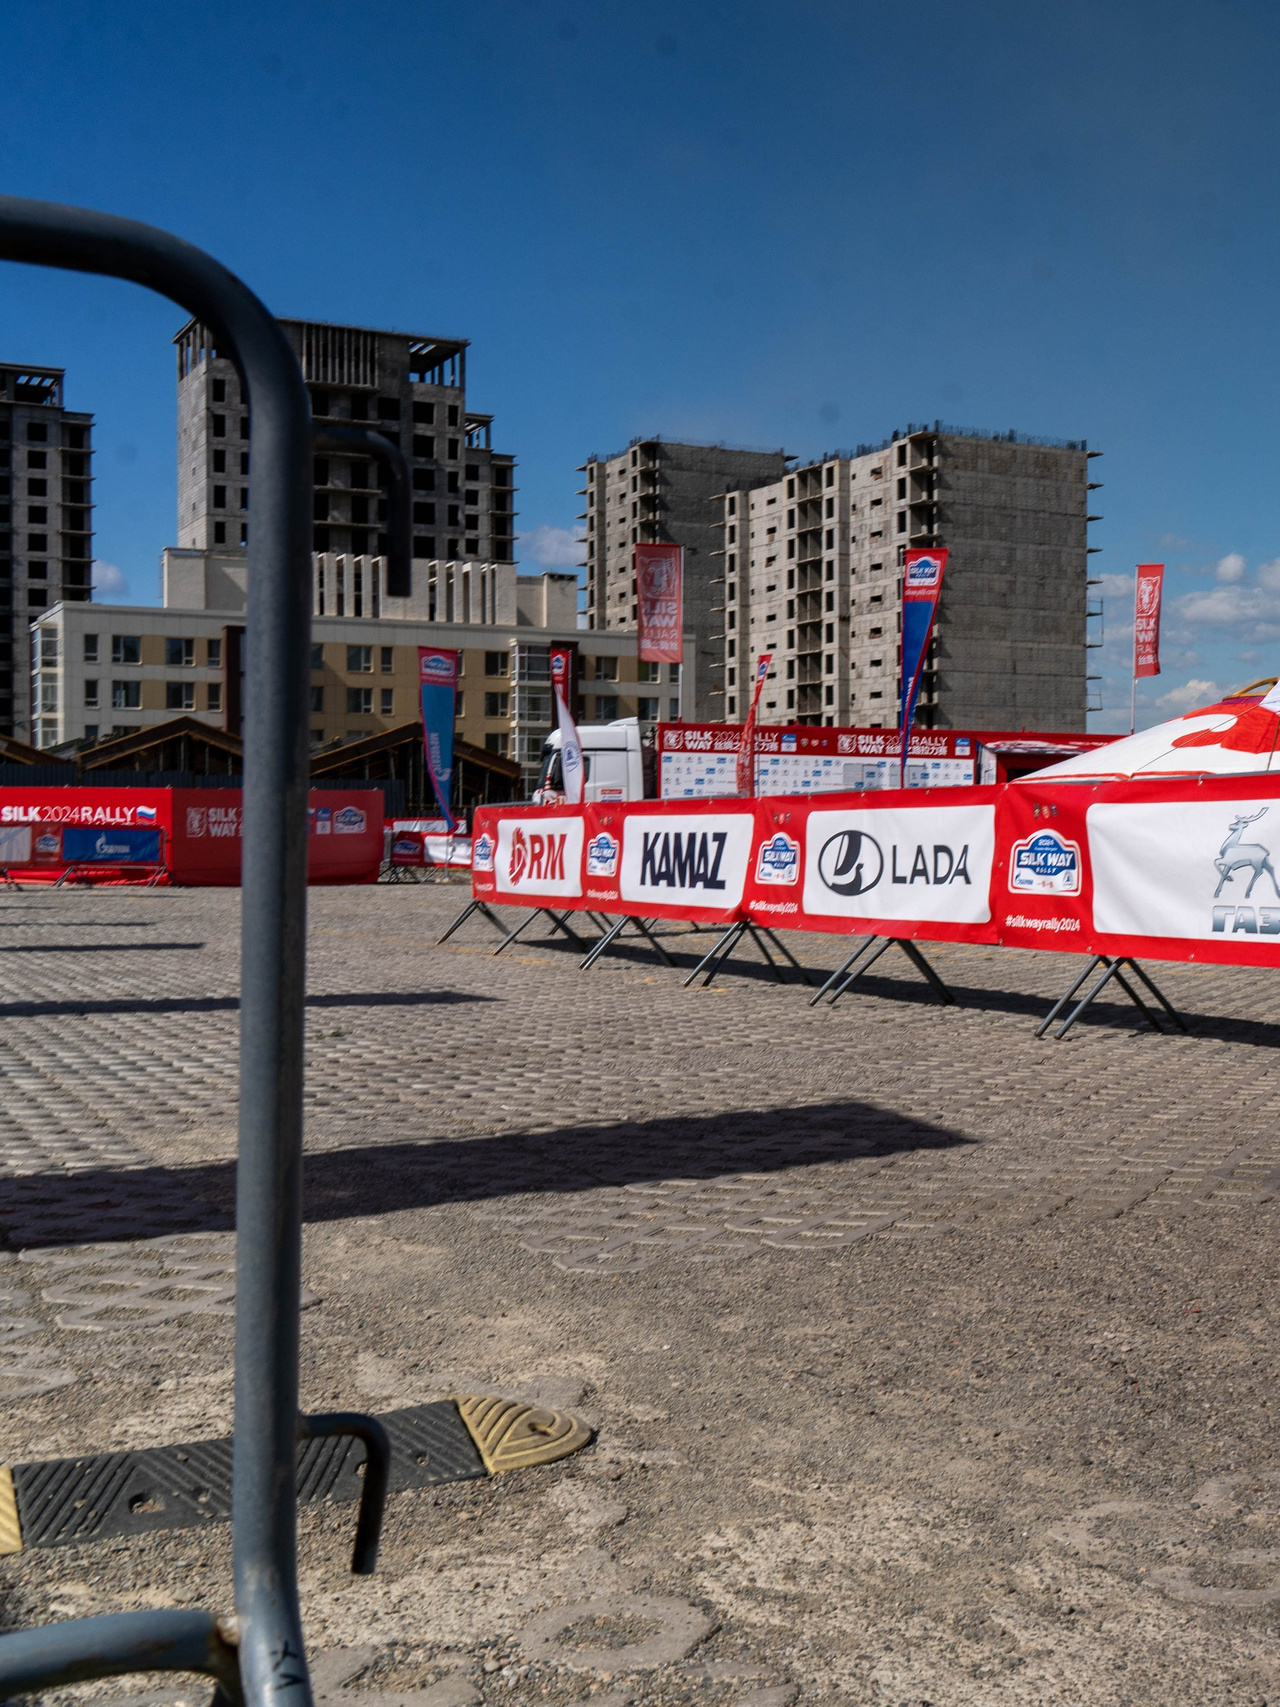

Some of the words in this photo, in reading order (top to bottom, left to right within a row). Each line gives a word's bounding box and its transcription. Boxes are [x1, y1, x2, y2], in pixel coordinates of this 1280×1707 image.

[684, 731, 713, 740] SILK
[857, 734, 885, 745] SILK
[911, 736, 948, 746] RALLY
[685, 740, 713, 751] WAY
[858, 744, 885, 754] WAY
[1, 805, 42, 822] SILK
[42, 805, 81, 823] 2024
[81, 806, 136, 823] RALLY
[208, 807, 237, 822] SILK
[208, 822, 237, 837] WAY
[527, 834, 567, 880] RM
[640, 832, 728, 889] KAMAZ
[892, 844, 972, 885] LADA
[1019, 852, 1047, 866] SILK
[1047, 853, 1073, 867] WAY
